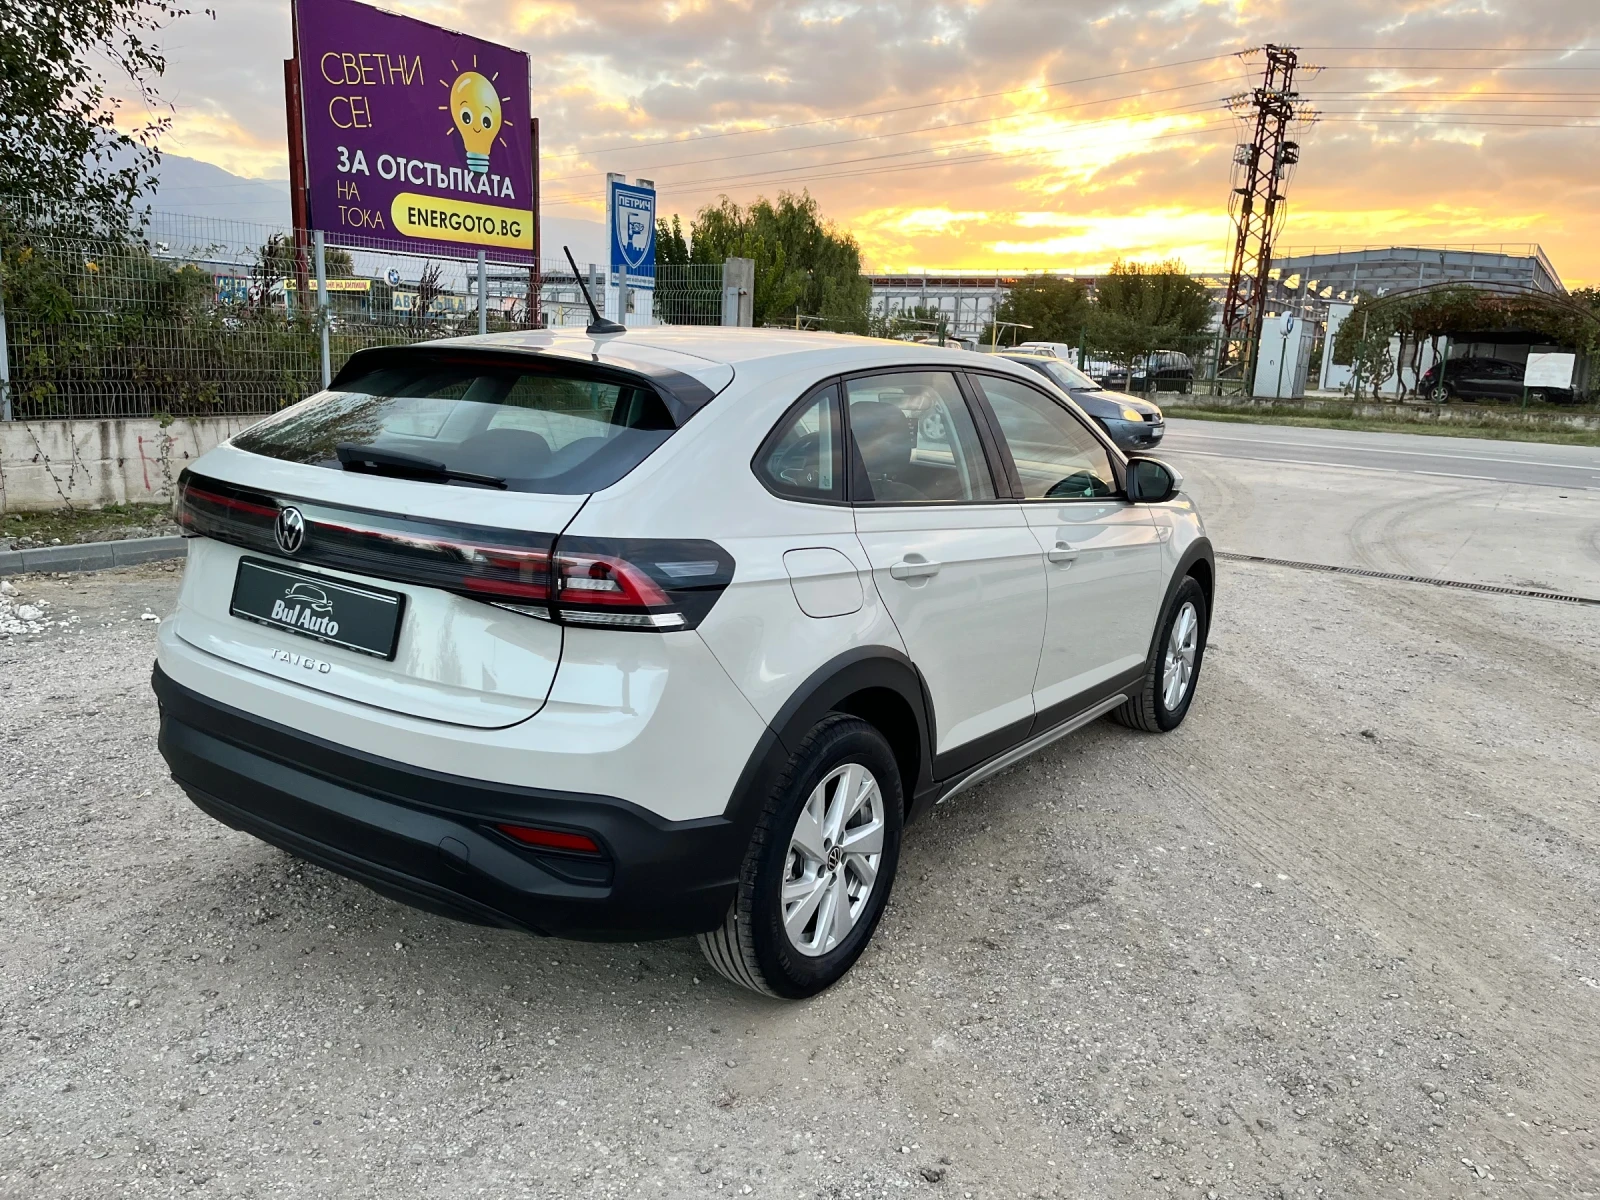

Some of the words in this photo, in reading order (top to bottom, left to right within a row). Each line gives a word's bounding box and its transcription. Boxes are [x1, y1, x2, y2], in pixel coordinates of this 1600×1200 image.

[321, 52, 424, 85] СВЕТНИ
[329, 96, 372, 128] СЕ!
[336, 146, 370, 176] ЗА
[377, 154, 516, 200] ОТСТЪПКАТА
[337, 180, 361, 202] НА
[618, 195, 651, 211] ПЕТРИЧ
[338, 205, 385, 230] ТОКА
[408, 206, 522, 238] ENERGOTO.BG
[271, 599, 301, 625] Bul
[298, 608, 339, 636] Auto
[270, 648, 332, 674] TAIGO
